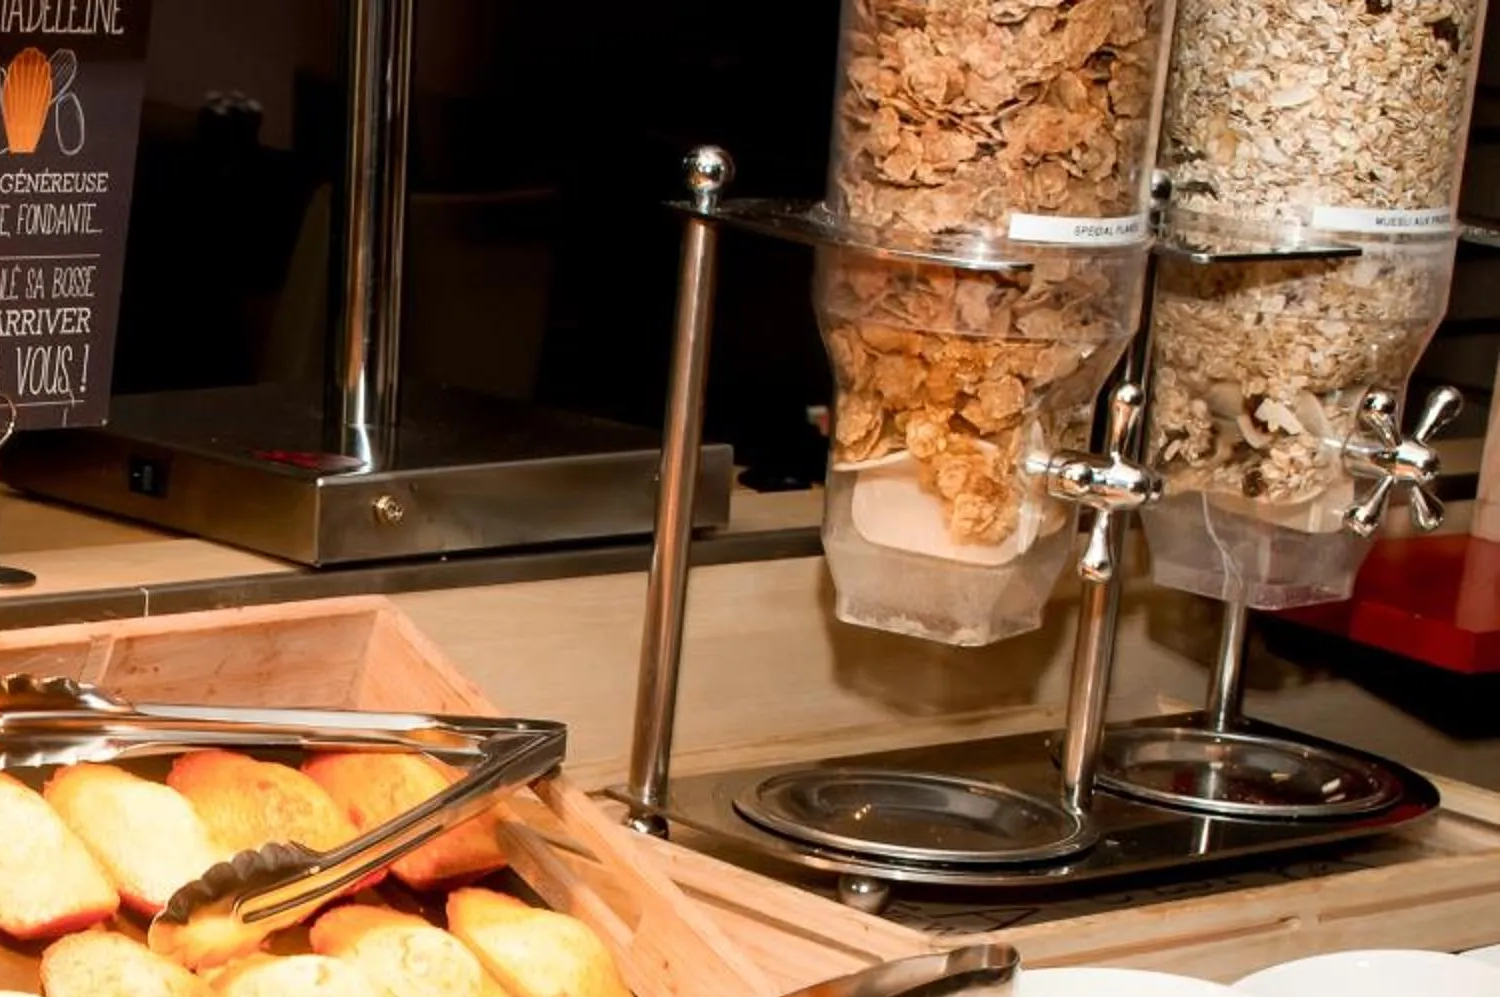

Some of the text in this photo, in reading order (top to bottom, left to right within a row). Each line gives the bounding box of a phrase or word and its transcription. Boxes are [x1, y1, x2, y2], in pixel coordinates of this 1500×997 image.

[0, 168, 109, 194] GÉNÉREUSE
[26, 268, 45, 299] SA
[52, 266, 96, 298] BOSSE
